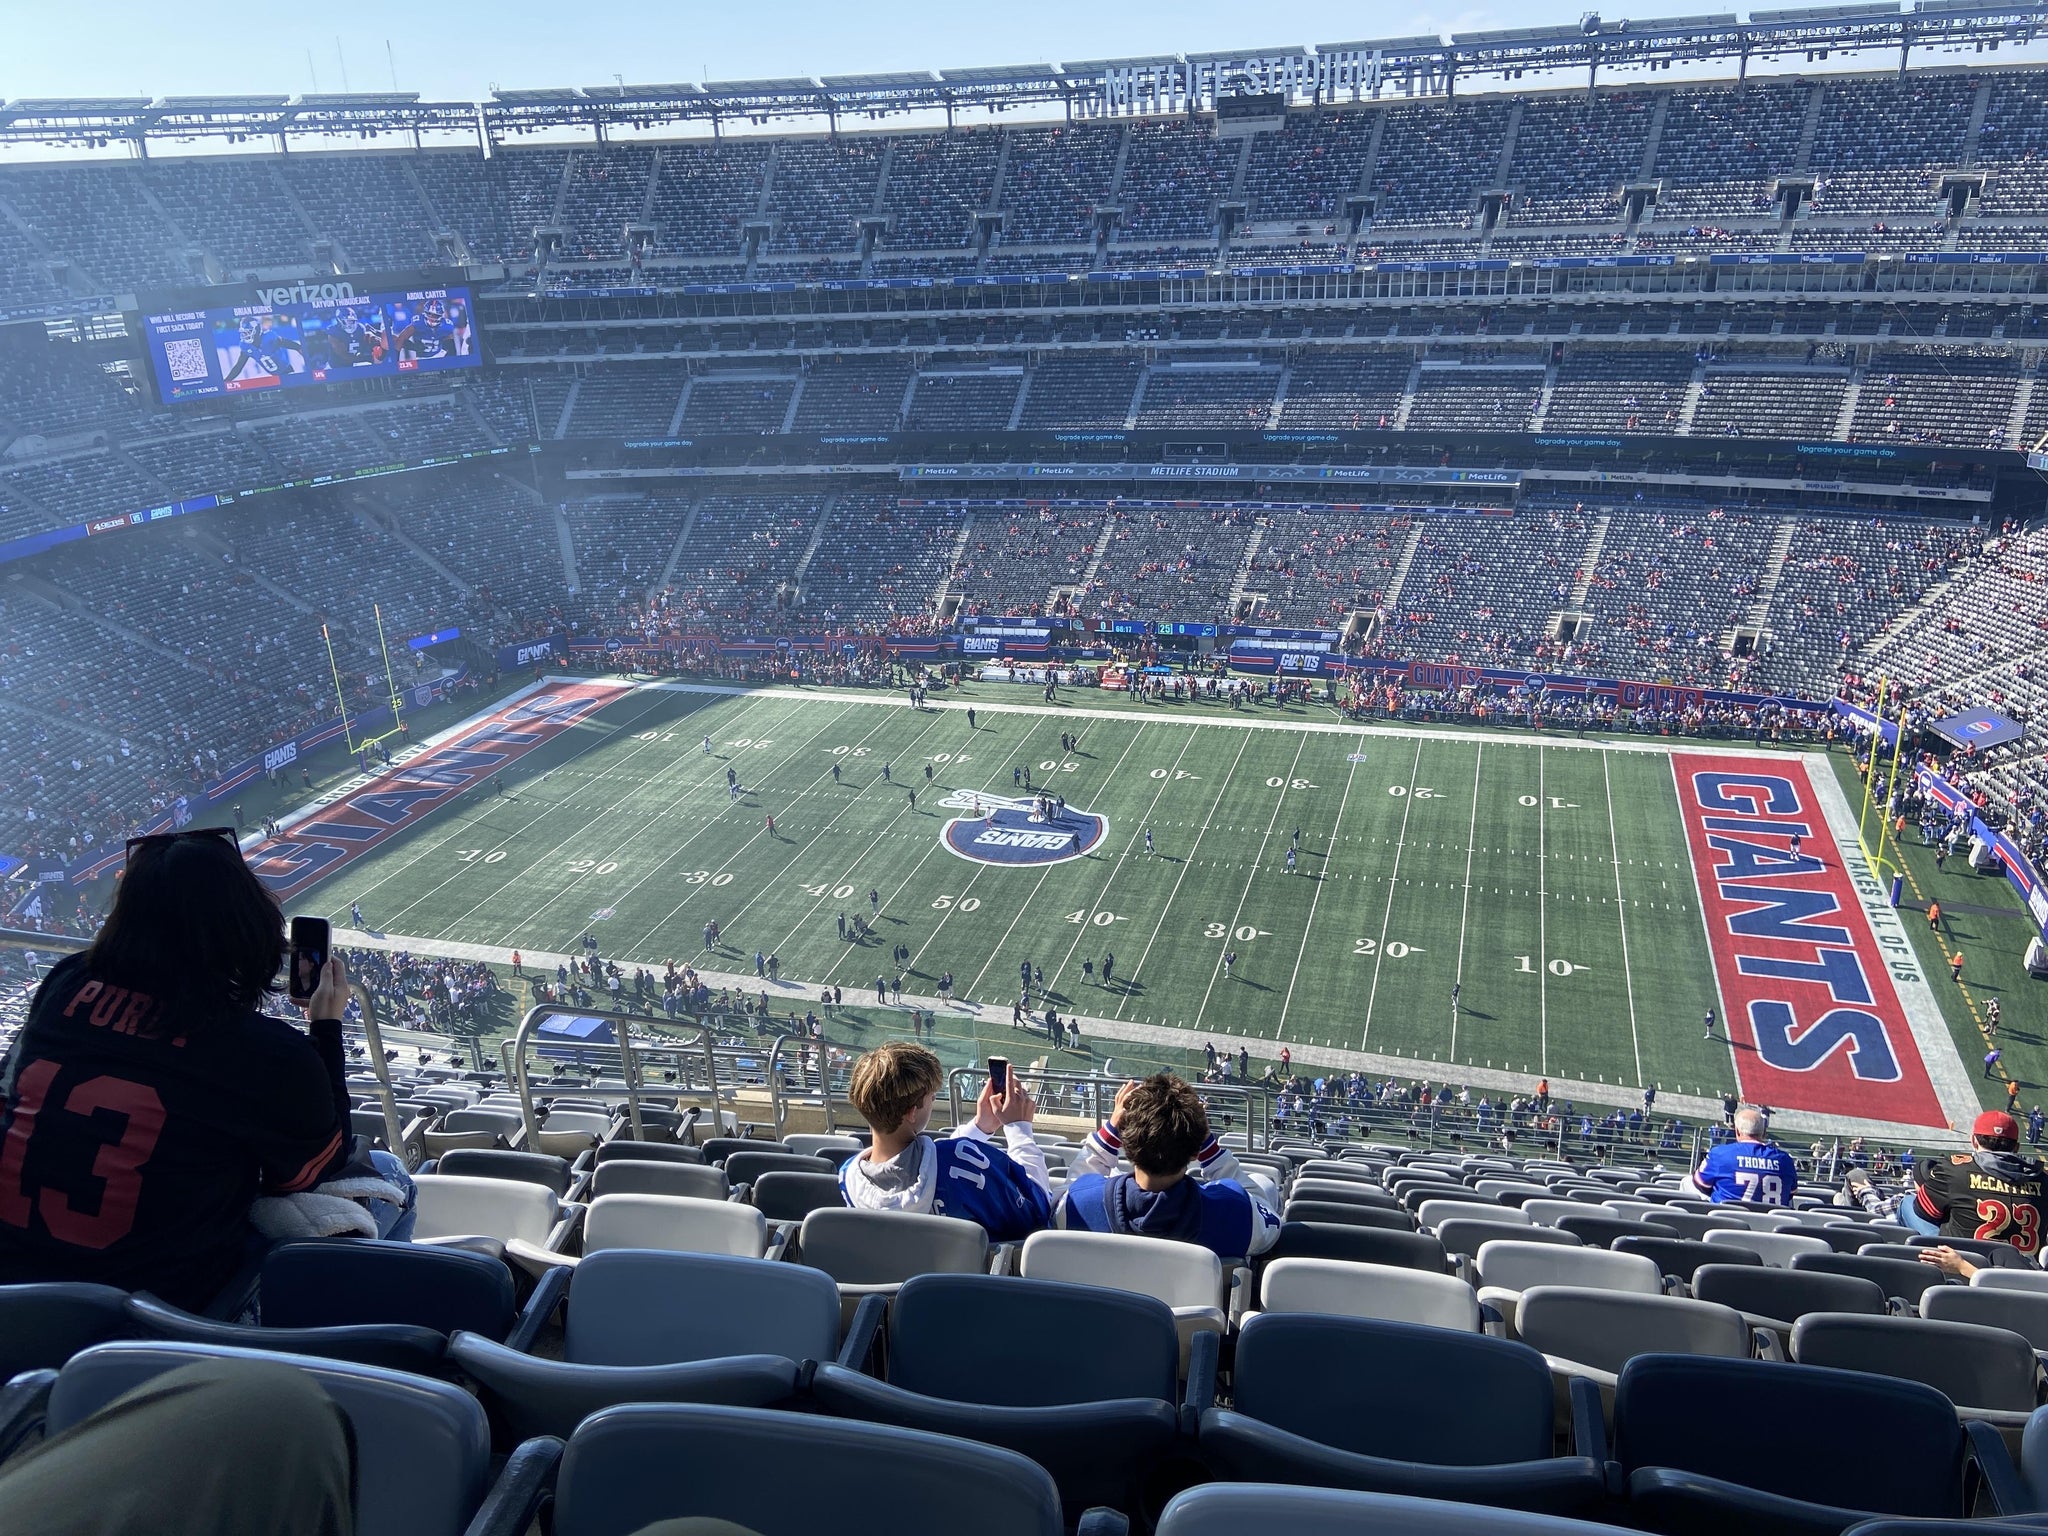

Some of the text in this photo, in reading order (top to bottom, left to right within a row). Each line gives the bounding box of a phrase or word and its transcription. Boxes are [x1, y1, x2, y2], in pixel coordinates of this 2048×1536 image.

[1105, 49, 1382, 105] METLIFE STADIUM
[256, 280, 354, 307] verizon
[406, 290, 447, 301] ABDUL CARTER
[233, 305, 273, 316] BRIAN BURNS
[312, 299, 335, 309] KAYVON
[175, 312, 196, 321] RECORD
[195, 311, 206, 319] THE
[156, 325, 171, 334] FIRST
[171, 324, 185, 332] SACK
[624, 440, 649, 448] Upgrade
[820, 436, 845, 444] Upgrade
[1055, 433, 1079, 441] Upgrade
[1112, 433, 1126, 441] day.
[1263, 433, 1290, 442] Upgrade
[1325, 434, 1339, 442] day.
[1534, 437, 1621, 447] Upgrade your game day.
[1797, 445, 1897, 457] Upgrade your game day.
[924, 467, 958, 475] MetLife
[1041, 467, 1074, 475] MetLife
[1150, 467, 1239, 476] METLIFE STADIUM
[1468, 472, 1507, 481] MetLife
[150, 506, 172, 518] GIANTS
[93, 517, 125, 531] 49ERS
[1159, 624, 1171, 634] 25
[1178, 624, 1185, 634] 0
[963, 637, 999, 650] GIANTS
[517, 642, 550, 663] GIANTS
[1413, 665, 1477, 687] GIANTS
[391, 698, 403, 708] 25
[265, 741, 297, 770] GIANTS
[1039, 761, 1080, 772] 50
[245, 695, 600, 891] GIANTS
[974, 830, 1073, 850] GIANTS
[459, 849, 508, 864] 10
[568, 858, 619, 875] 20
[39, 871, 64, 881] GIANTS
[685, 870, 734, 886] 30
[806, 882, 854, 899] 40
[931, 895, 981, 912] 50
[1839, 839, 1921, 982] IT TAKES ALL OF US
[1064, 909, 1116, 926] 40
[1204, 922, 1258, 941] 30
[1692, 771, 1903, 1083] GIANTS
[1353, 938, 1411, 958] 20
[1514, 955, 1573, 977] 10
[0, 1058, 167, 1250] 13
[949, 1140, 990, 1190] 10
[1736, 1155, 1780, 1171] THOMAS
[1735, 1172, 1783, 1205] 78
[1973, 1198, 2041, 1256] 23
